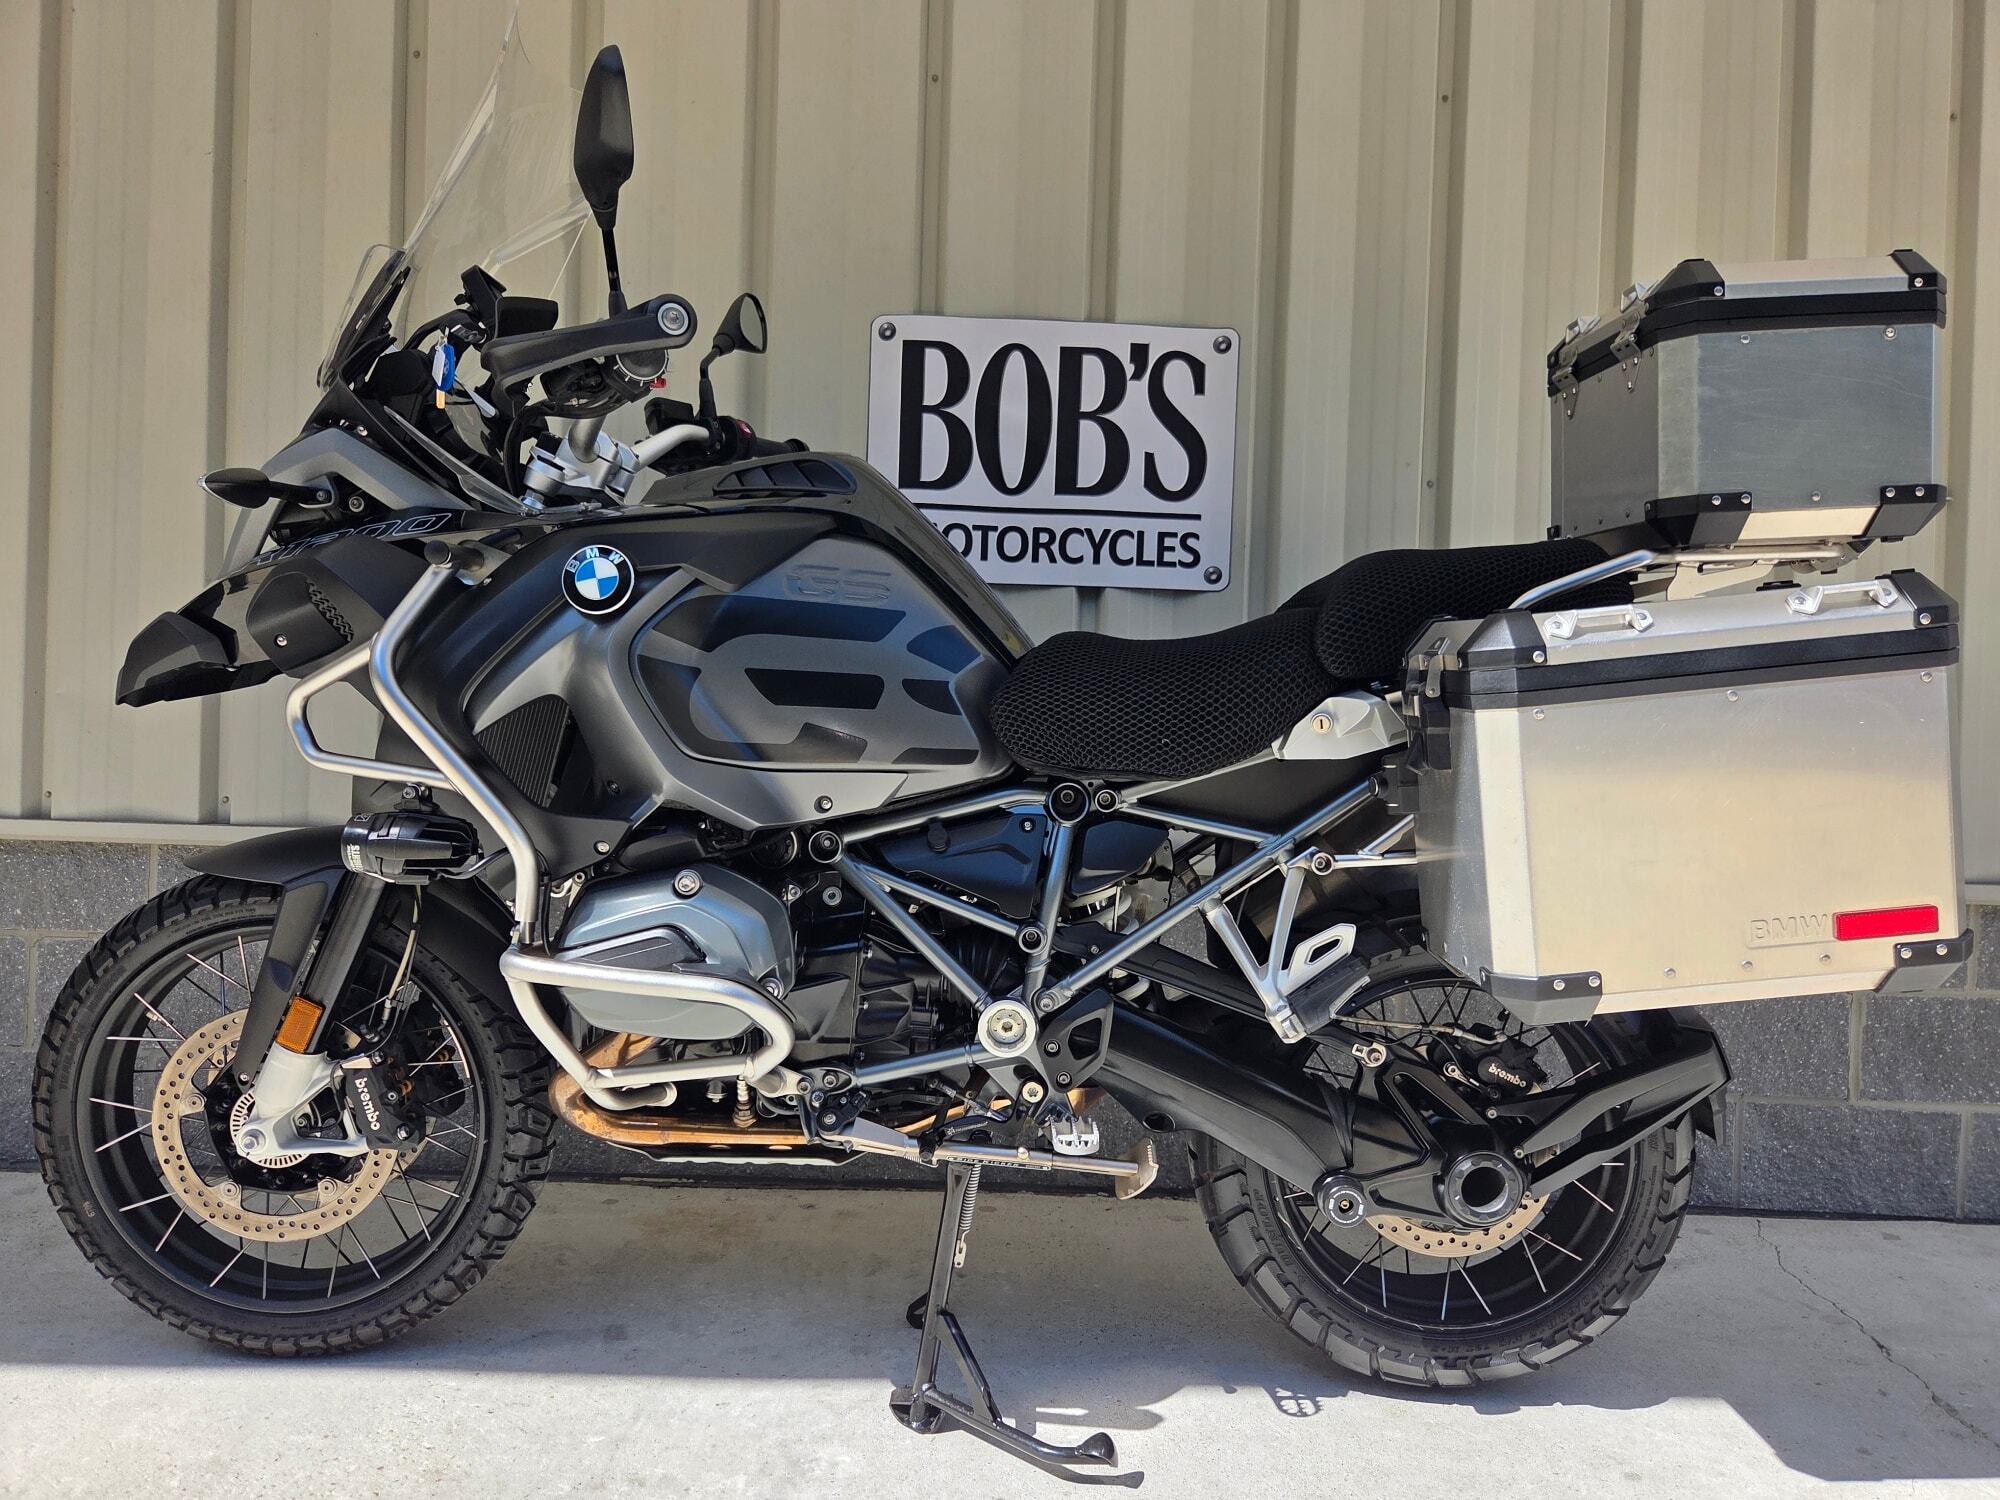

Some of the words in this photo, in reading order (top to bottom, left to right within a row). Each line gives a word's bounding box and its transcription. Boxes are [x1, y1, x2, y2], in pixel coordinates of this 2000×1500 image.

[898, 339, 1208, 502] BOB'S
[566, 547, 625, 573] BMW
[932, 521, 1202, 569] OTORCYCLES
[1749, 913, 1829, 941] BMW
[1488, 1063, 1527, 1088] brembo
[355, 1077, 380, 1131] brembo
